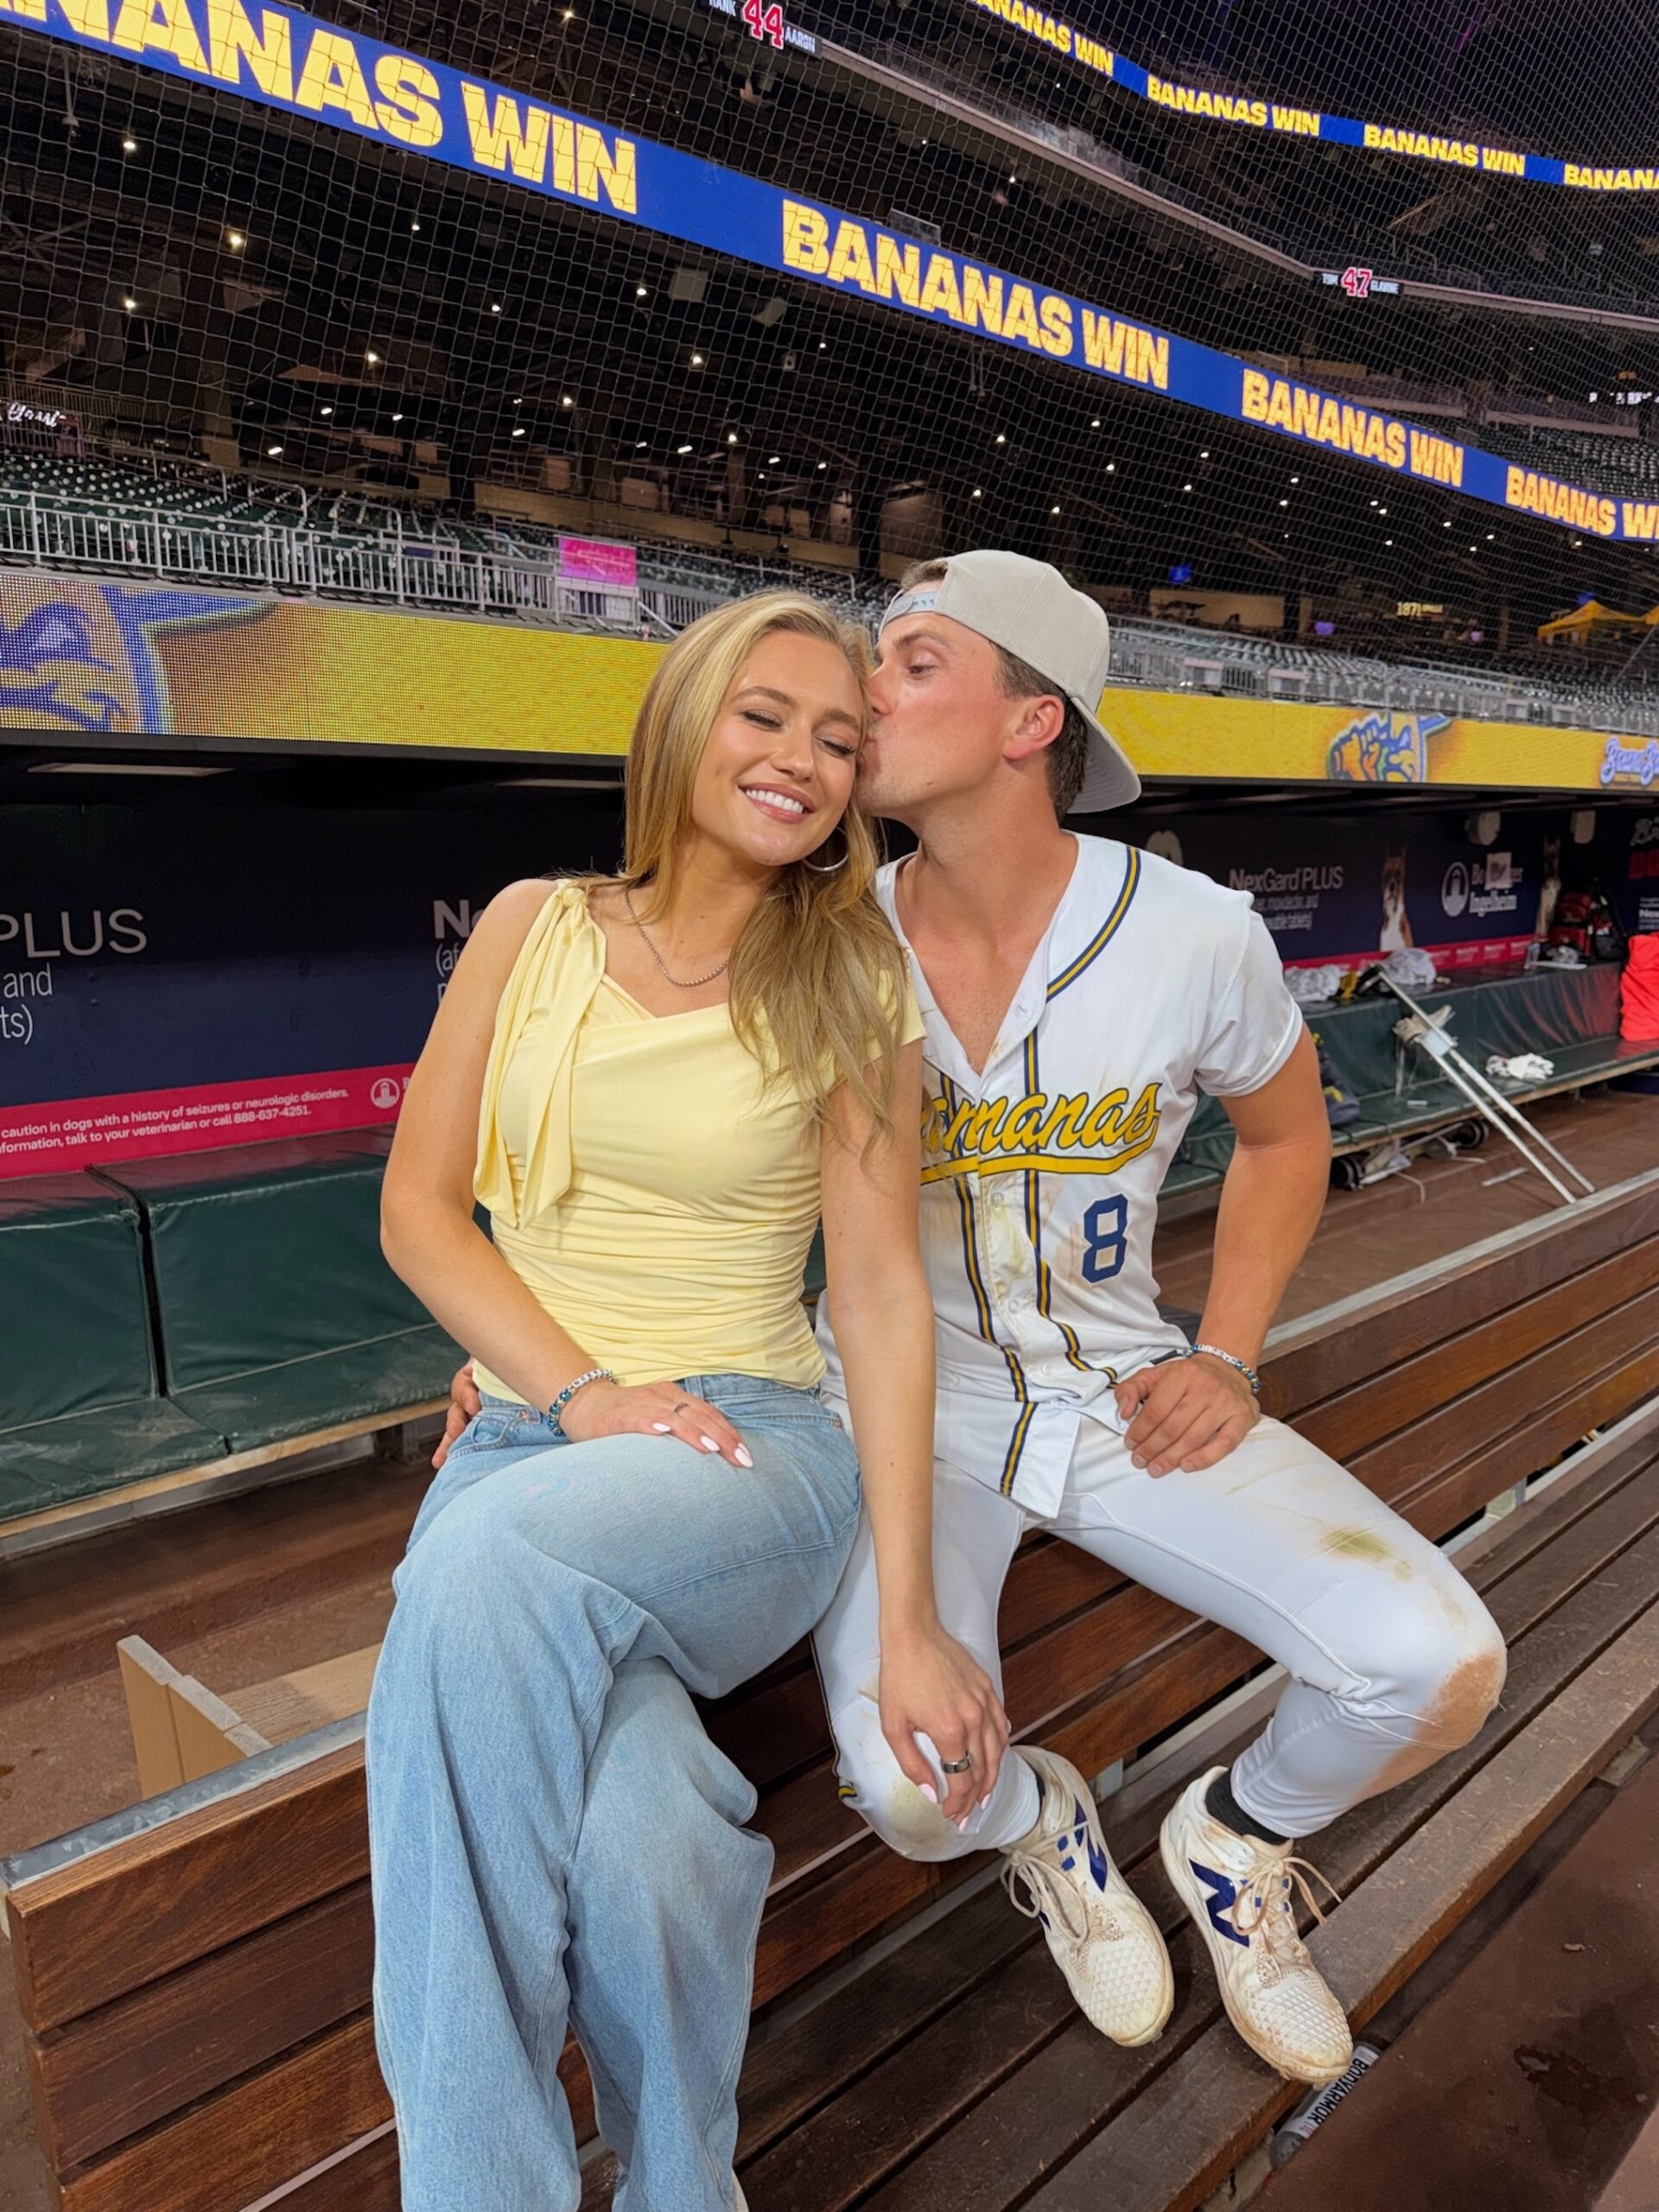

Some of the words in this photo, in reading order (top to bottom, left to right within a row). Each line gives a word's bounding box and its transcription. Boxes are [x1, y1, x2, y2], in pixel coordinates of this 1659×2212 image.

[743, 0, 784, 50] 44
[1074, 33, 1114, 77] WIN
[1147, 74, 1268, 126] BANANAS
[1271, 105, 1320, 137] WIN
[461, 81, 638, 214] WIN
[1363, 124, 1478, 167] BANANAS
[1482, 147, 1525, 175] WIN
[1564, 163, 1659, 190] BANAN
[783, 199, 1073, 357] BANANAS
[1081, 308, 1169, 390] WIN
[1341, 267, 1372, 297] 47
[1242, 369, 1406, 467] BANANAS
[1410, 429, 1464, 487] WIN
[1506, 466, 1617, 536] BANANAS
[1229, 868, 1300, 892] NexGard
[1302, 866, 1344, 890] PLUS
[0, 909, 147, 958] PLUS
[3, 963, 53, 998] and
[1, 1124, 48, 1139] caution
[50, 1122, 60, 1133] in
[63, 1120, 92, 1132] dogs
[94, 1114, 120, 1128] with
[122, 1116, 130, 1124] a
[131, 1109, 170, 1123] history
[172, 1106, 184, 1118] of
[186, 1102, 231, 1116] seizures
[232, 1101, 243, 1110] or
[245, 1093, 300, 1109] neurologic
[301, 1088, 349, 1102] disorders.
[65, 1133, 87, 1146] talk
[90, 1133, 103, 1142] to
[105, 1129, 130, 1142] your
[132, 1118, 197, 1137] veterinarian
[200, 1118, 212, 1128] or
[213, 1115, 232, 1127] call
[1082, 1193, 1128, 1284] 8
[1307, 2057, 1370, 2126] BODYARMOR
